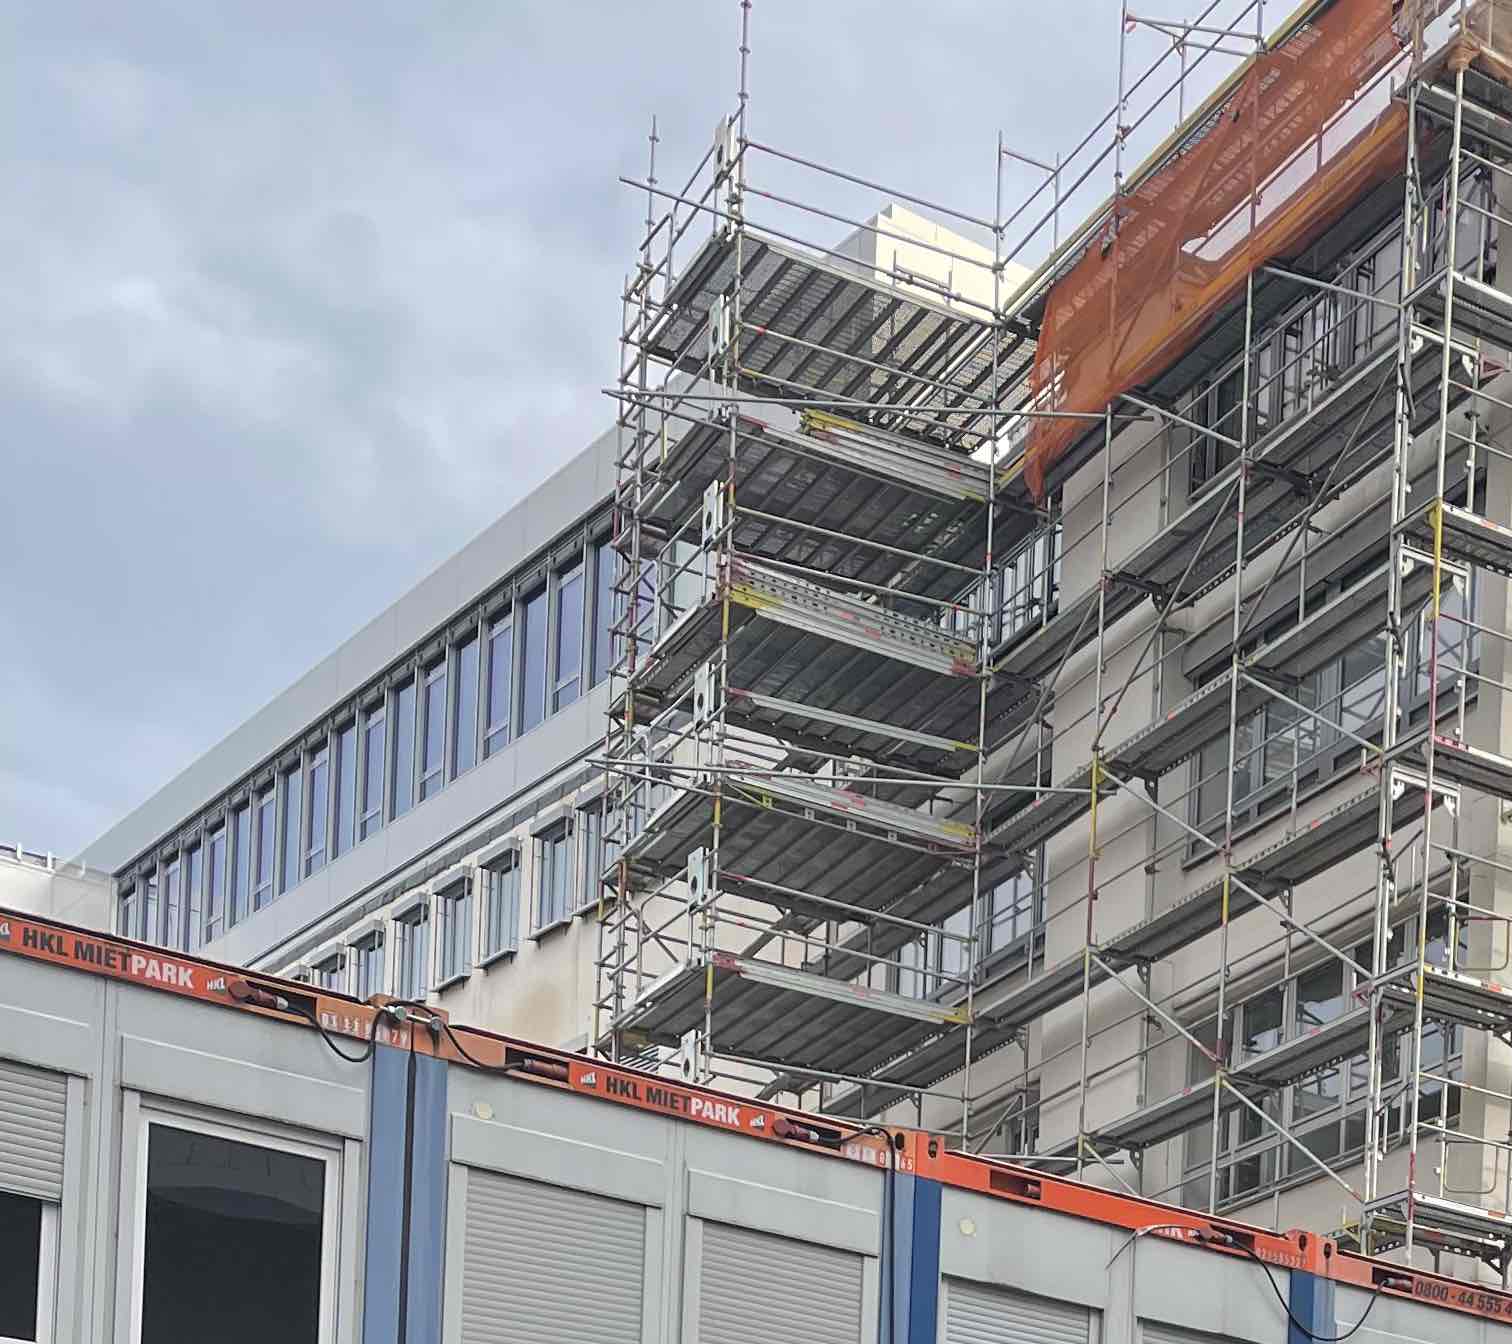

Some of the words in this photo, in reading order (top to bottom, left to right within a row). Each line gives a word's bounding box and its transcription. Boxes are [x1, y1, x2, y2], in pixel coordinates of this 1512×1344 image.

[22, 927, 68, 957] HKL
[73, 939, 195, 989] MIETPARK
[606, 1076, 641, 1100] HKL
[645, 1085, 740, 1127] MIETPARK
[1415, 1282, 1449, 1300] 0800
[1457, 1291, 1474, 1307] 44
